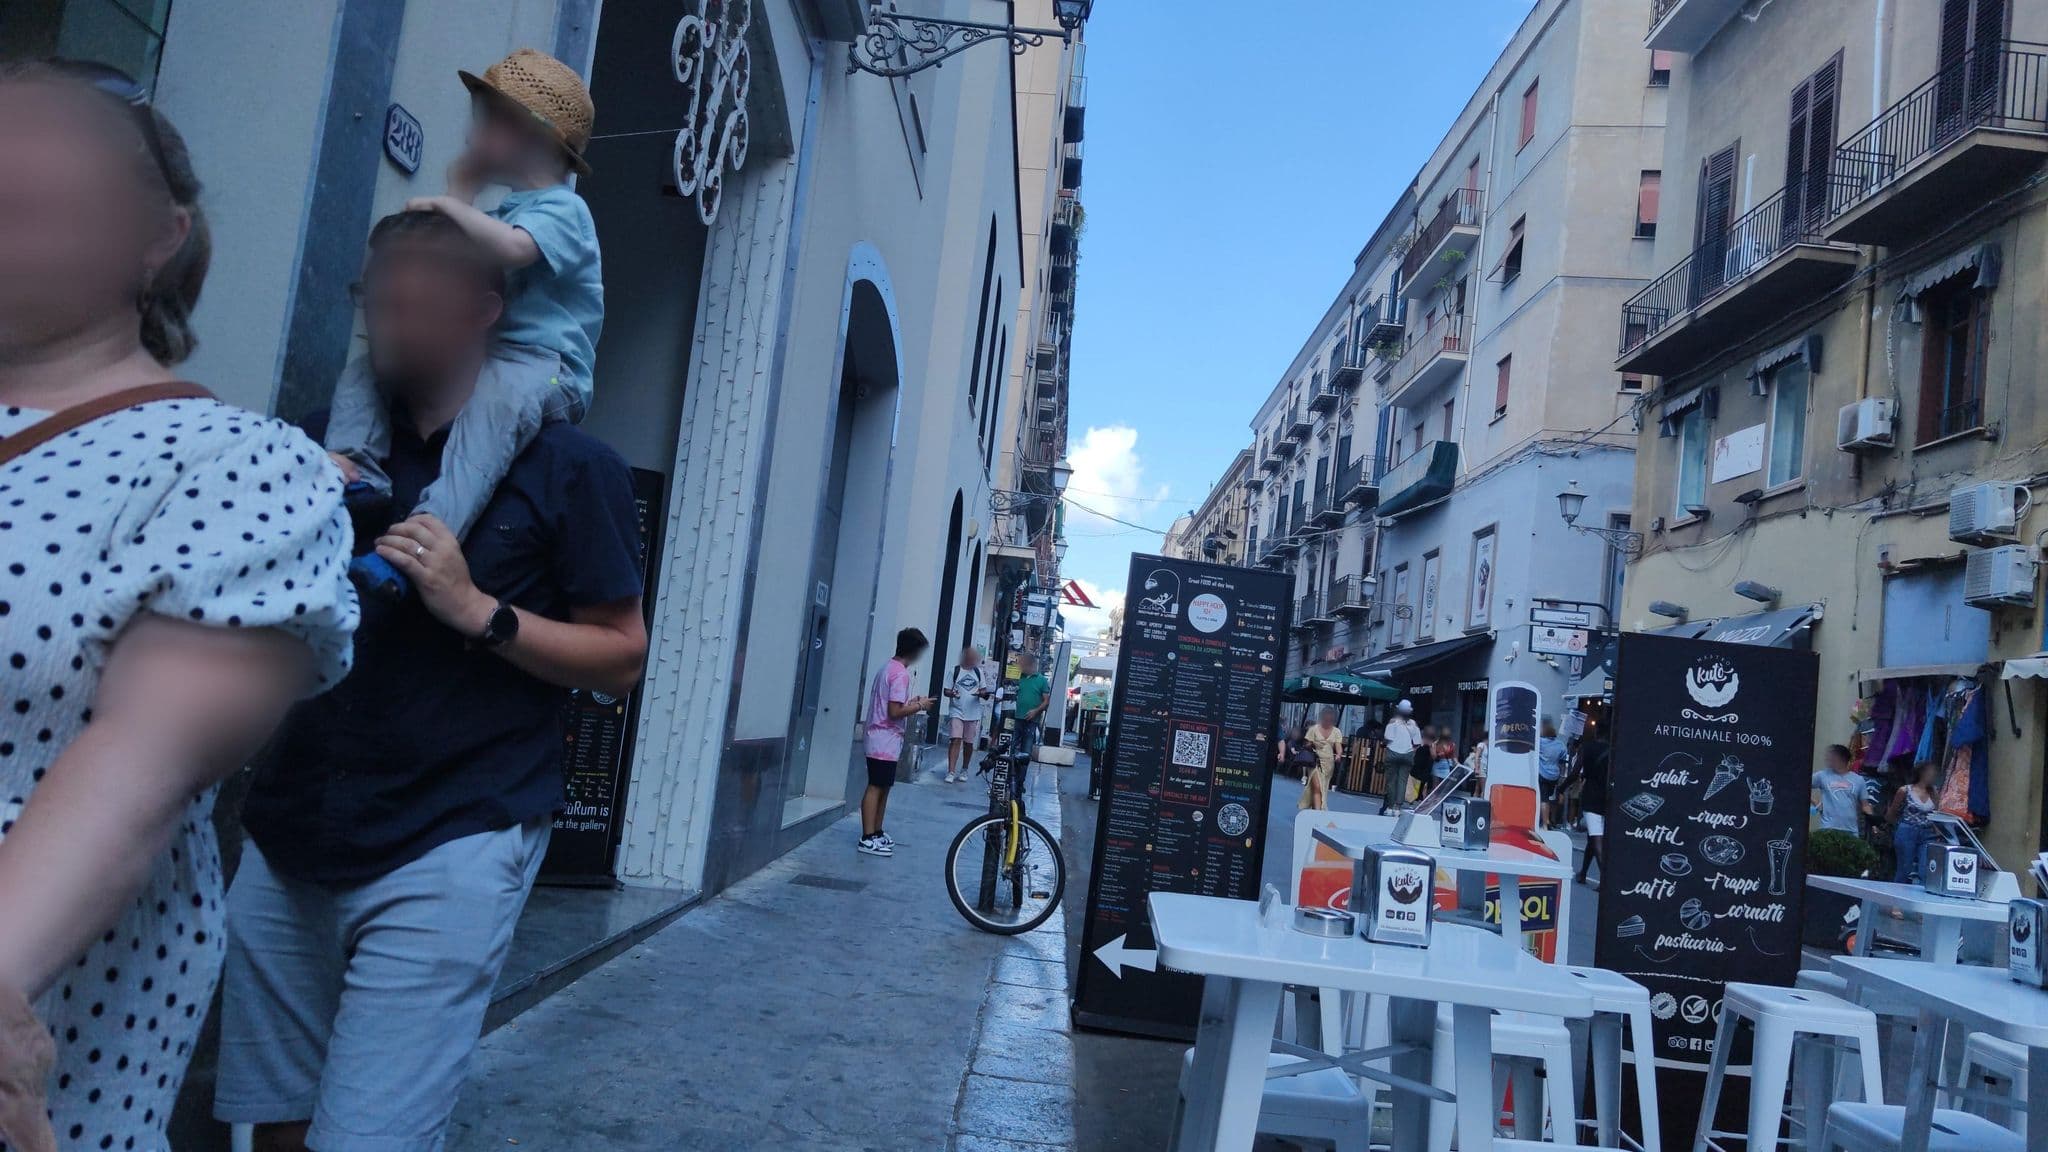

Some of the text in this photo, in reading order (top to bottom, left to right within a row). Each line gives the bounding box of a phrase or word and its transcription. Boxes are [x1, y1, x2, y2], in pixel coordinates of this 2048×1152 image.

[390, 113, 420, 162] 288
[1654, 724, 1773, 747] ARTIGIANALE 100%
[1641, 768, 1699, 788] gelati
[600, 804, 609, 817] is
[566, 819, 578, 829] the
[580, 820, 607, 832] gallery
[1714, 903, 1786, 923] cornetti
[1654, 932, 1737, 953] pasticceria
